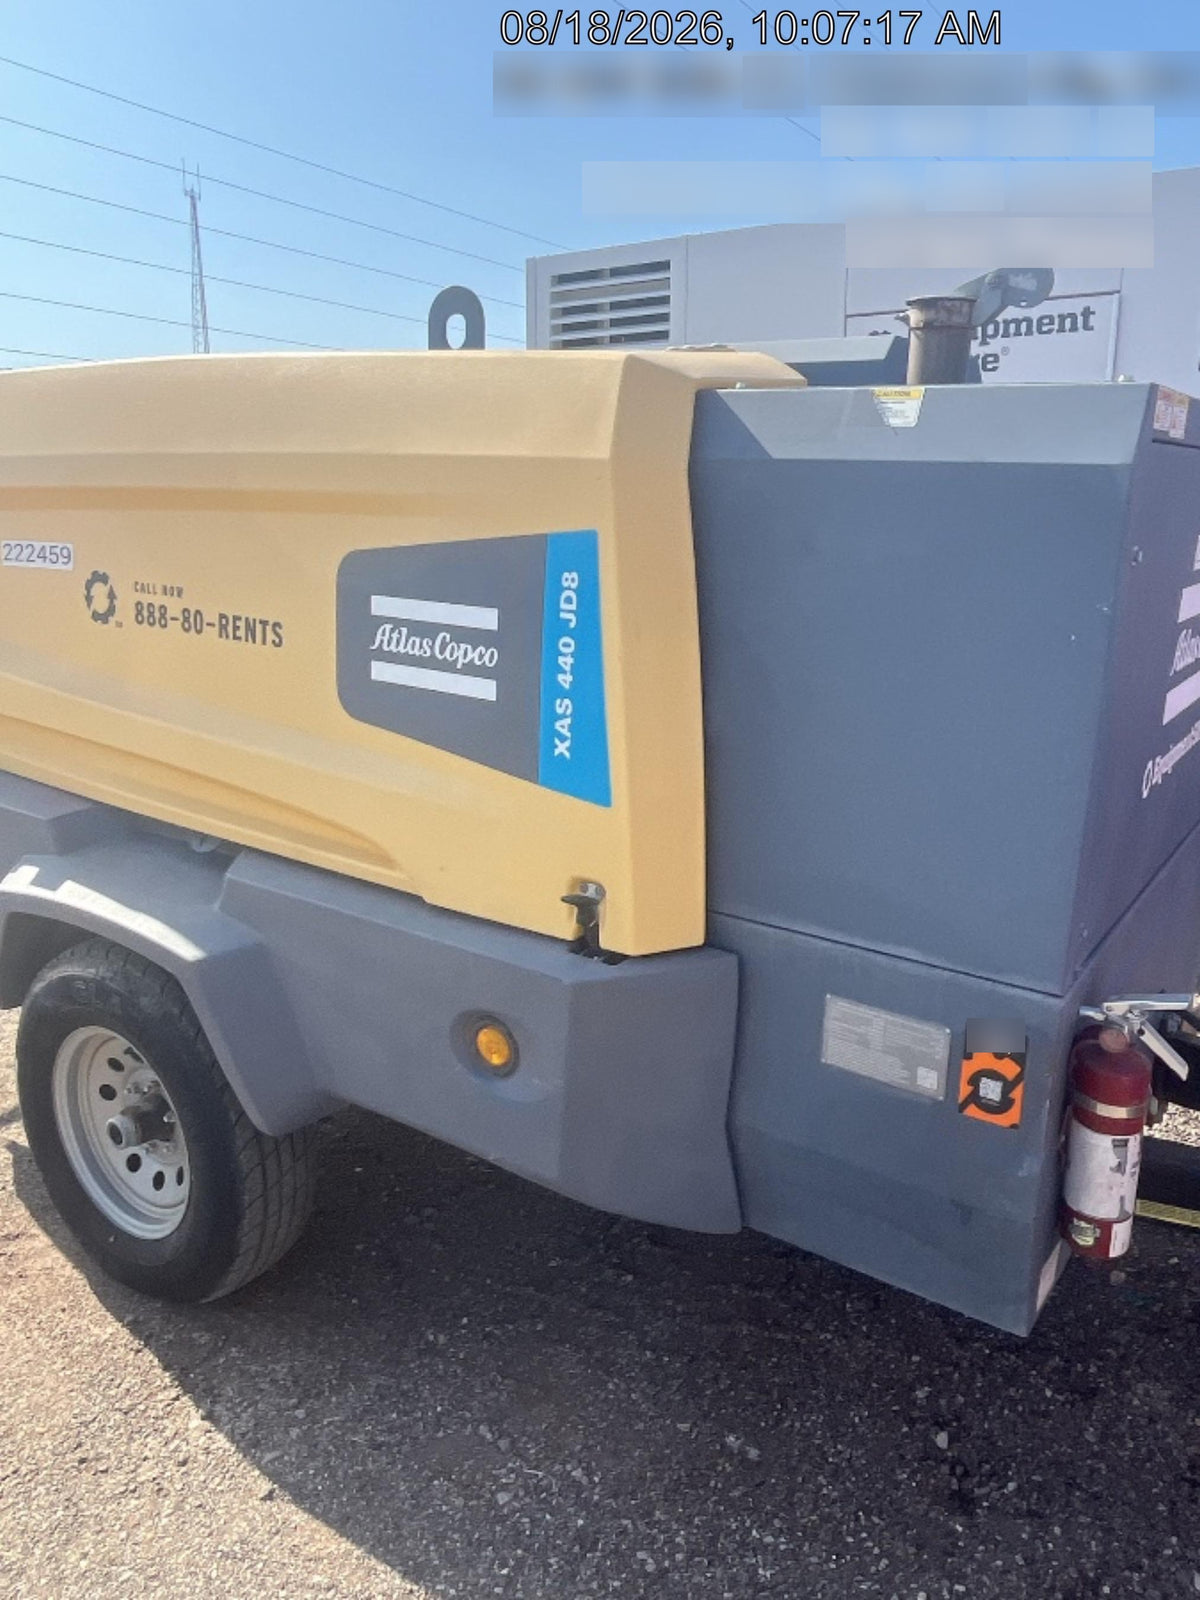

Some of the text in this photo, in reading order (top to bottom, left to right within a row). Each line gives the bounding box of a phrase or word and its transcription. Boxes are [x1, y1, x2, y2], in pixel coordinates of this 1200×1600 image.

[2, 543, 72, 566] 222459
[134, 581, 184, 598] CALL NOW
[134, 600, 284, 648] 888-80-RENTS
[370, 623, 498, 669] Atlas Copco
[554, 571, 580, 760] XAS 440 JD8
